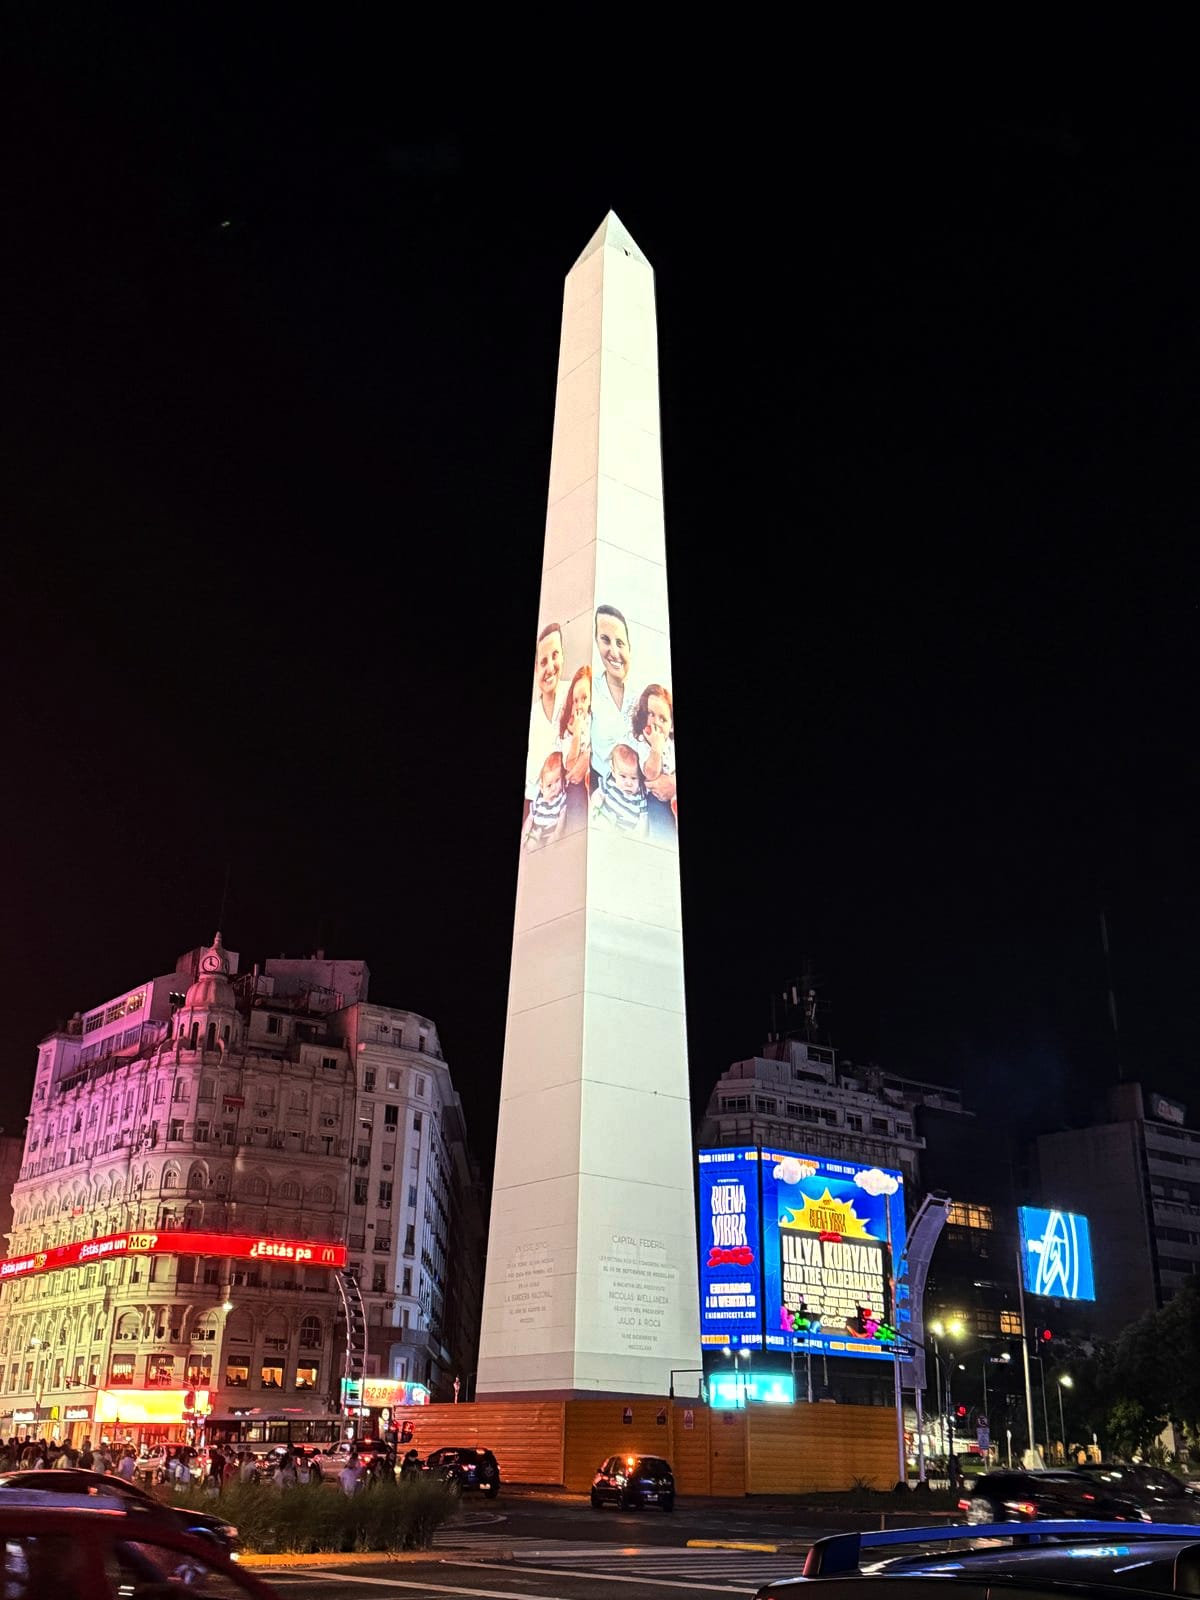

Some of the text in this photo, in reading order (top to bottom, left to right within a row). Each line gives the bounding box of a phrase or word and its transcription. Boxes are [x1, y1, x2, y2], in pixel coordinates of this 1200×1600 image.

[711, 1185, 746, 1215] BUENA
[712, 1214, 748, 1246] VIBRA
[810, 1208, 829, 1230] BUENA
[114, 1238, 127, 1250] un
[250, 1242, 293, 1257] ¿Estás
[296, 1248, 312, 1261] pa
[782, 1235, 883, 1275] ILLYA KURYAKI
